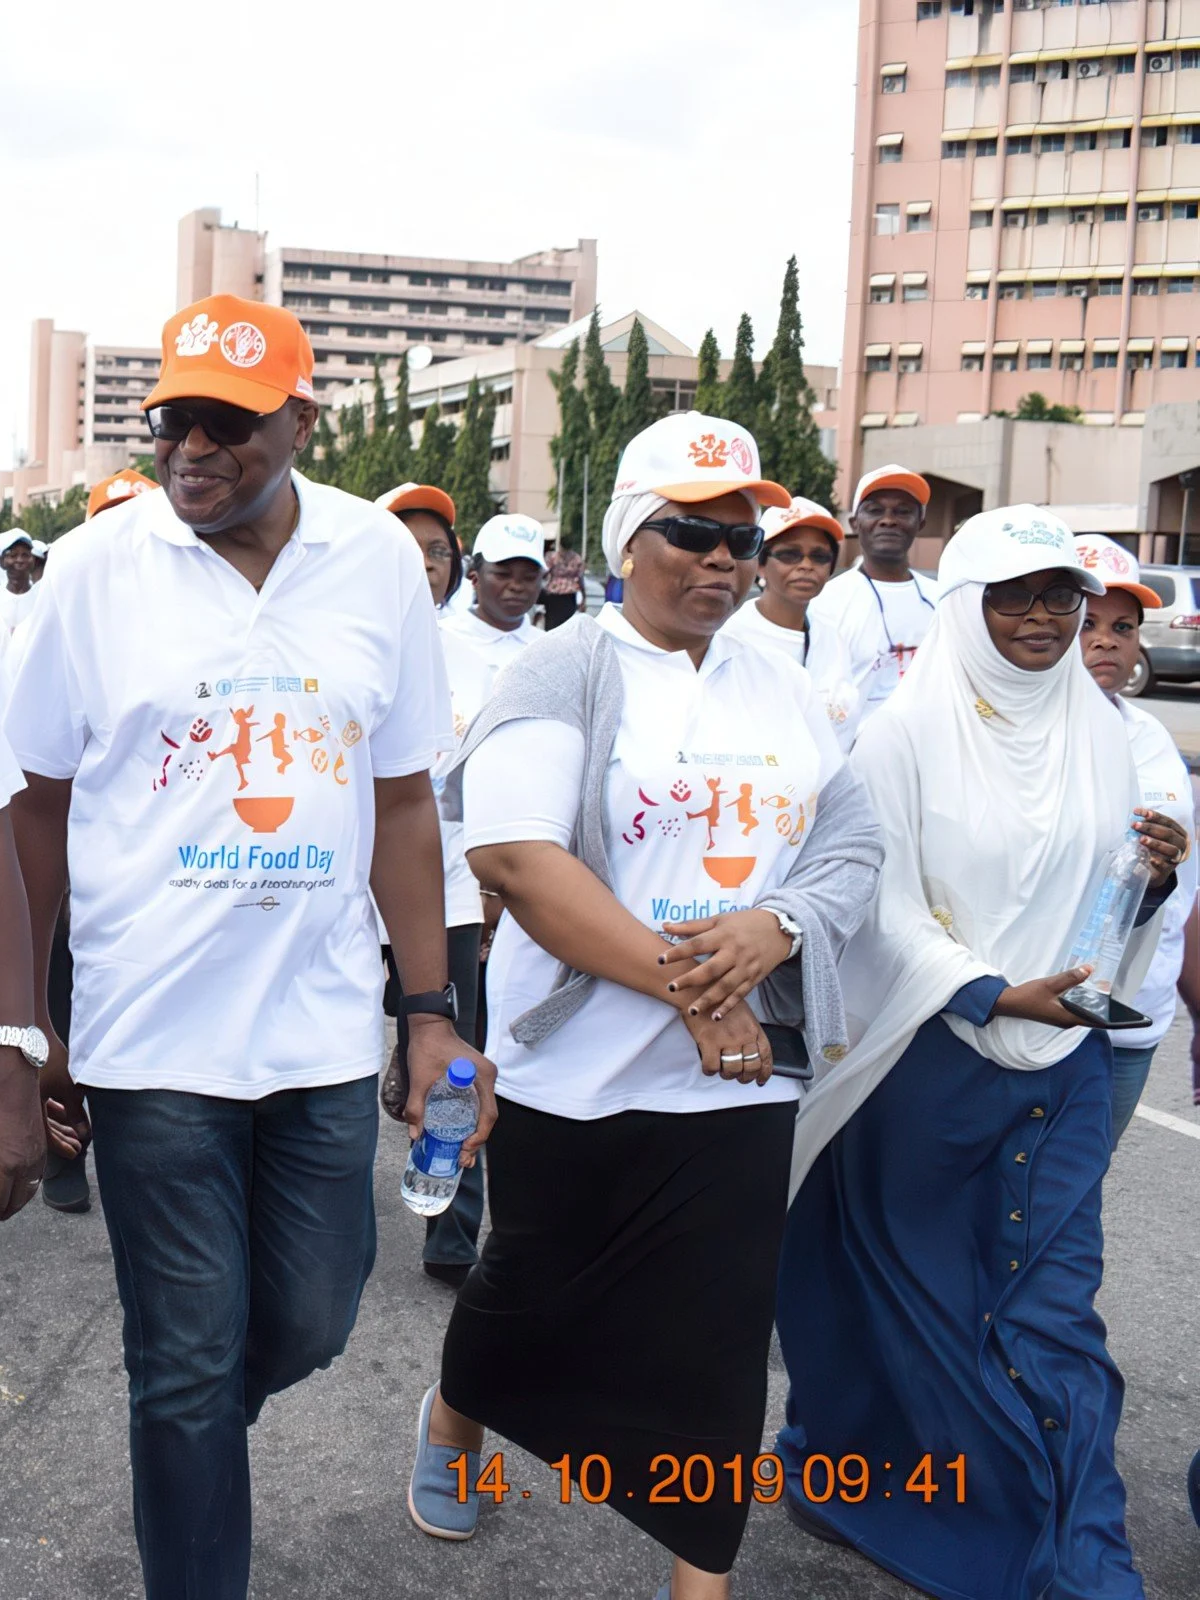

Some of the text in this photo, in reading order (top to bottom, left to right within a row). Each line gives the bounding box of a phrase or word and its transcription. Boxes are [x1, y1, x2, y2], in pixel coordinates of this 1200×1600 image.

[178, 845, 335, 874] World Food Day
[652, 898, 710, 921] World
